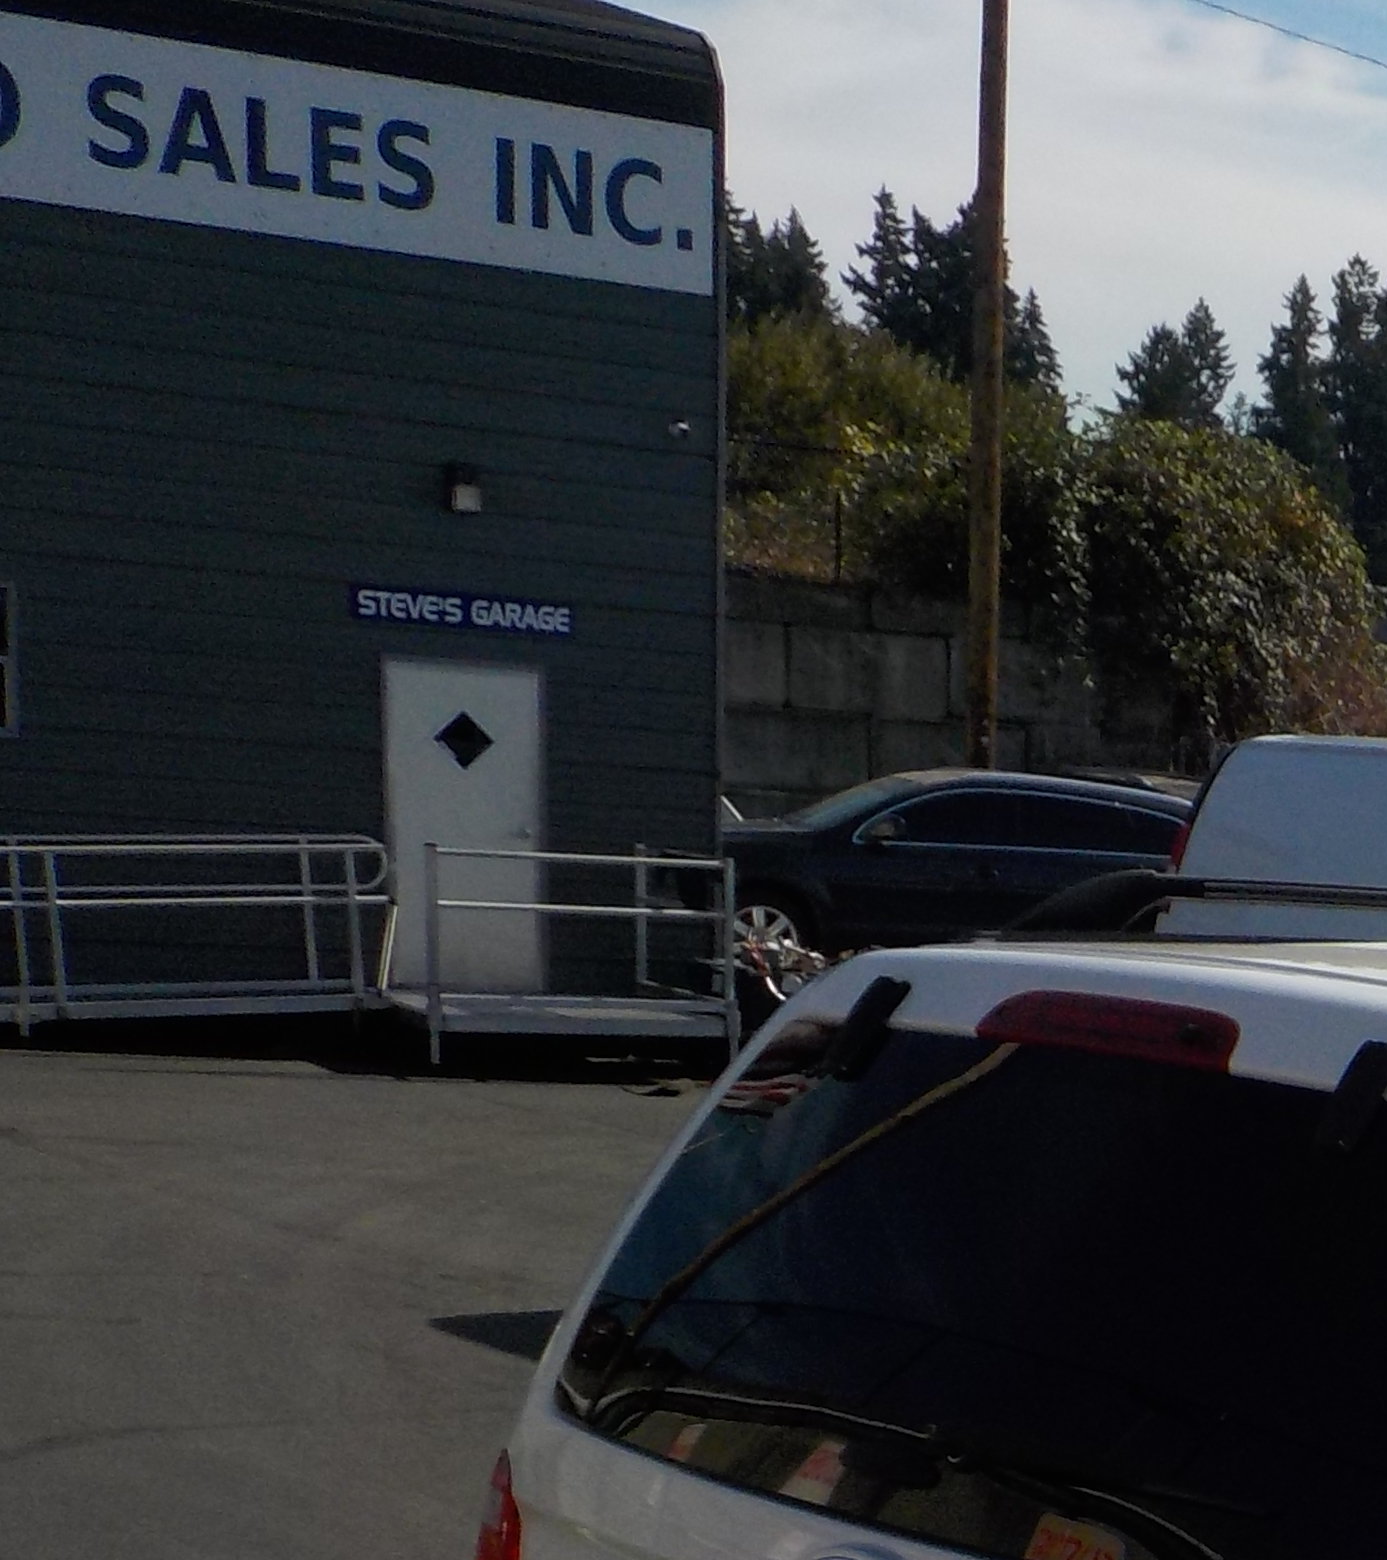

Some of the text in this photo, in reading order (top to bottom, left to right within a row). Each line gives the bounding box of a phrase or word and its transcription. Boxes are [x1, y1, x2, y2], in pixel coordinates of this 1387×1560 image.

[86, 73, 436, 211] SALES
[495, 137, 694, 251] INC.
[357, 589, 571, 633] STEVE'S GARAGE
